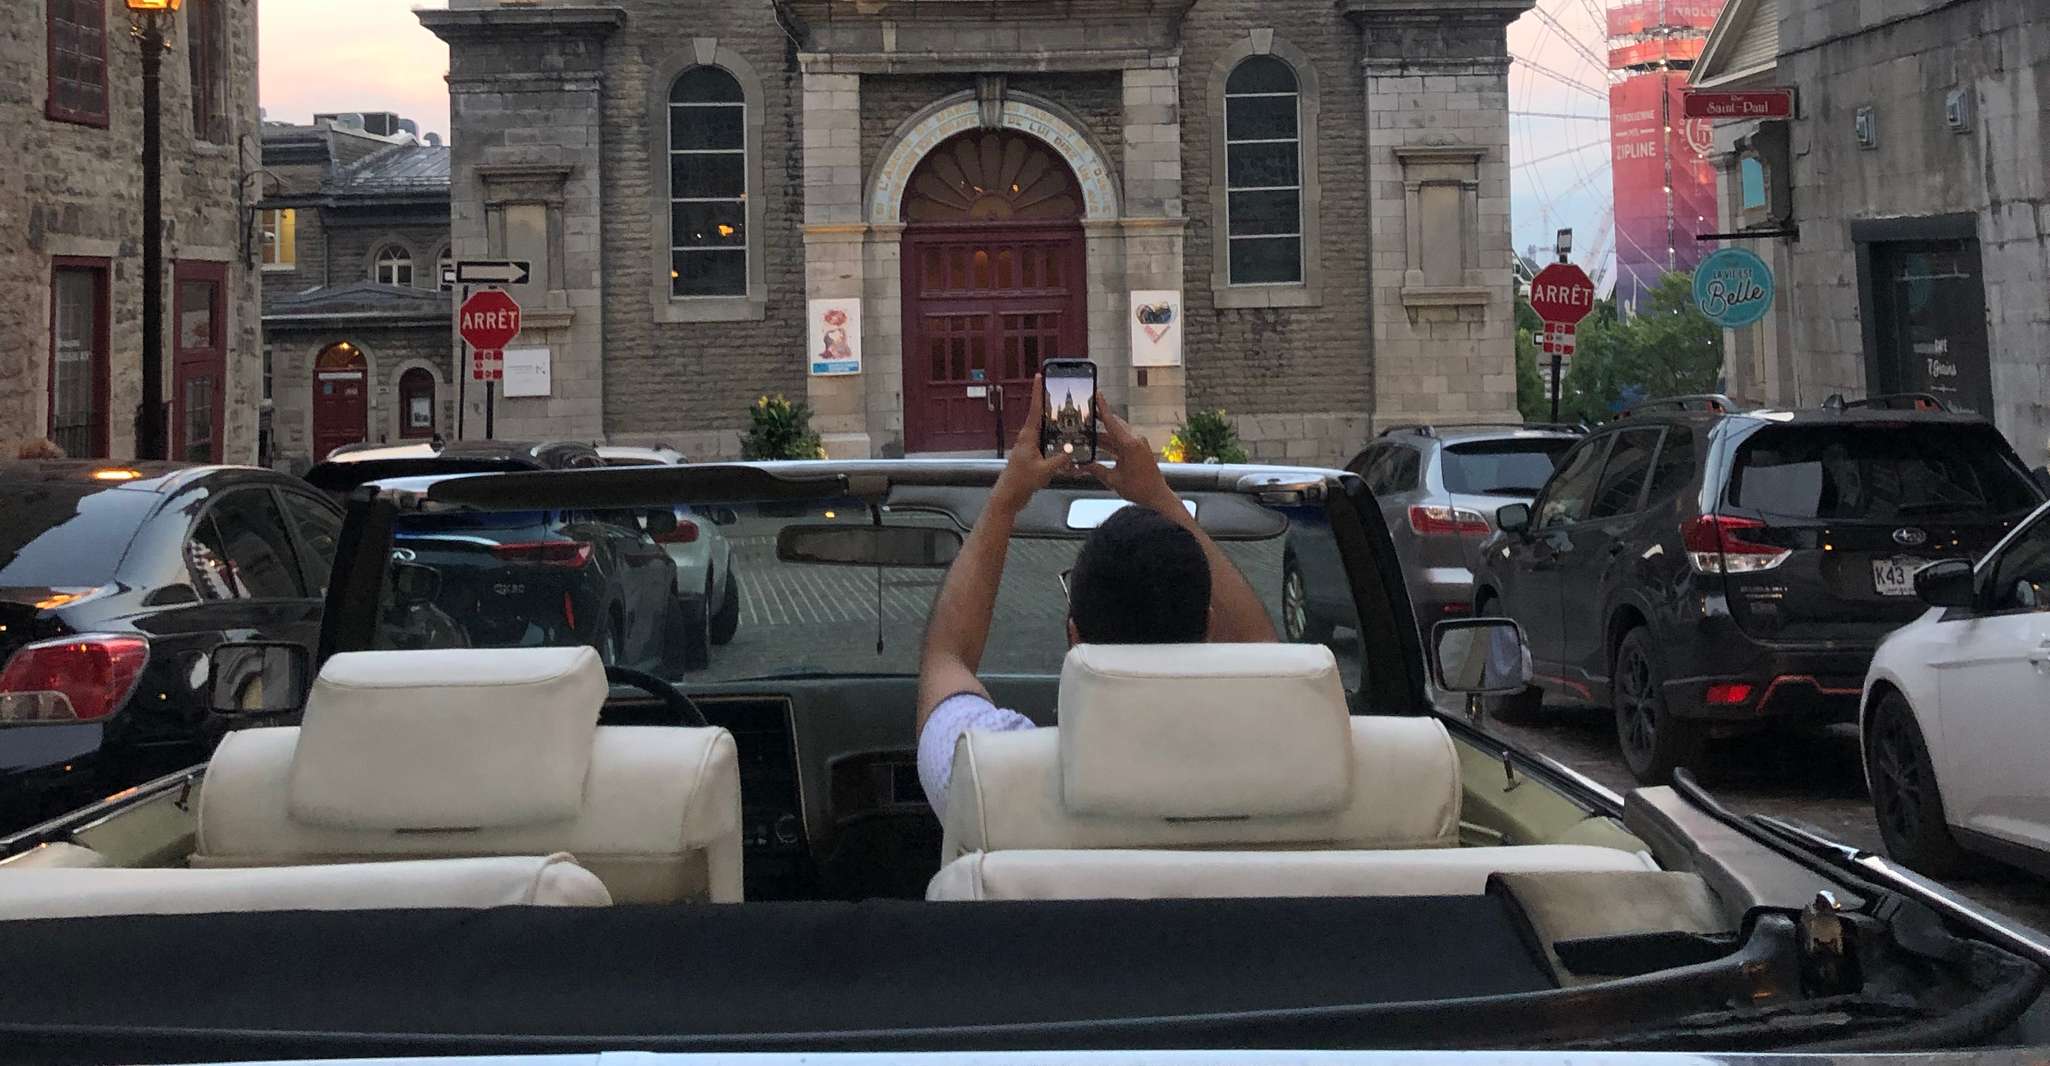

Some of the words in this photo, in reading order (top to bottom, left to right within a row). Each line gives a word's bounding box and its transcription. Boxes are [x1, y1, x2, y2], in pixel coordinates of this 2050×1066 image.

[1672, 7, 1720, 17] TYROLIE
[1706, 101, 1769, 114] Saint-Paul
[1028, 122, 1051, 138] LUI
[1616, 141, 1656, 160] ZIPLINE
[1534, 283, 1592, 306] ARRÊT
[1701, 278, 1765, 317] Belle
[462, 307, 518, 330] ARRÊT
[1875, 566, 1905, 585] K43
